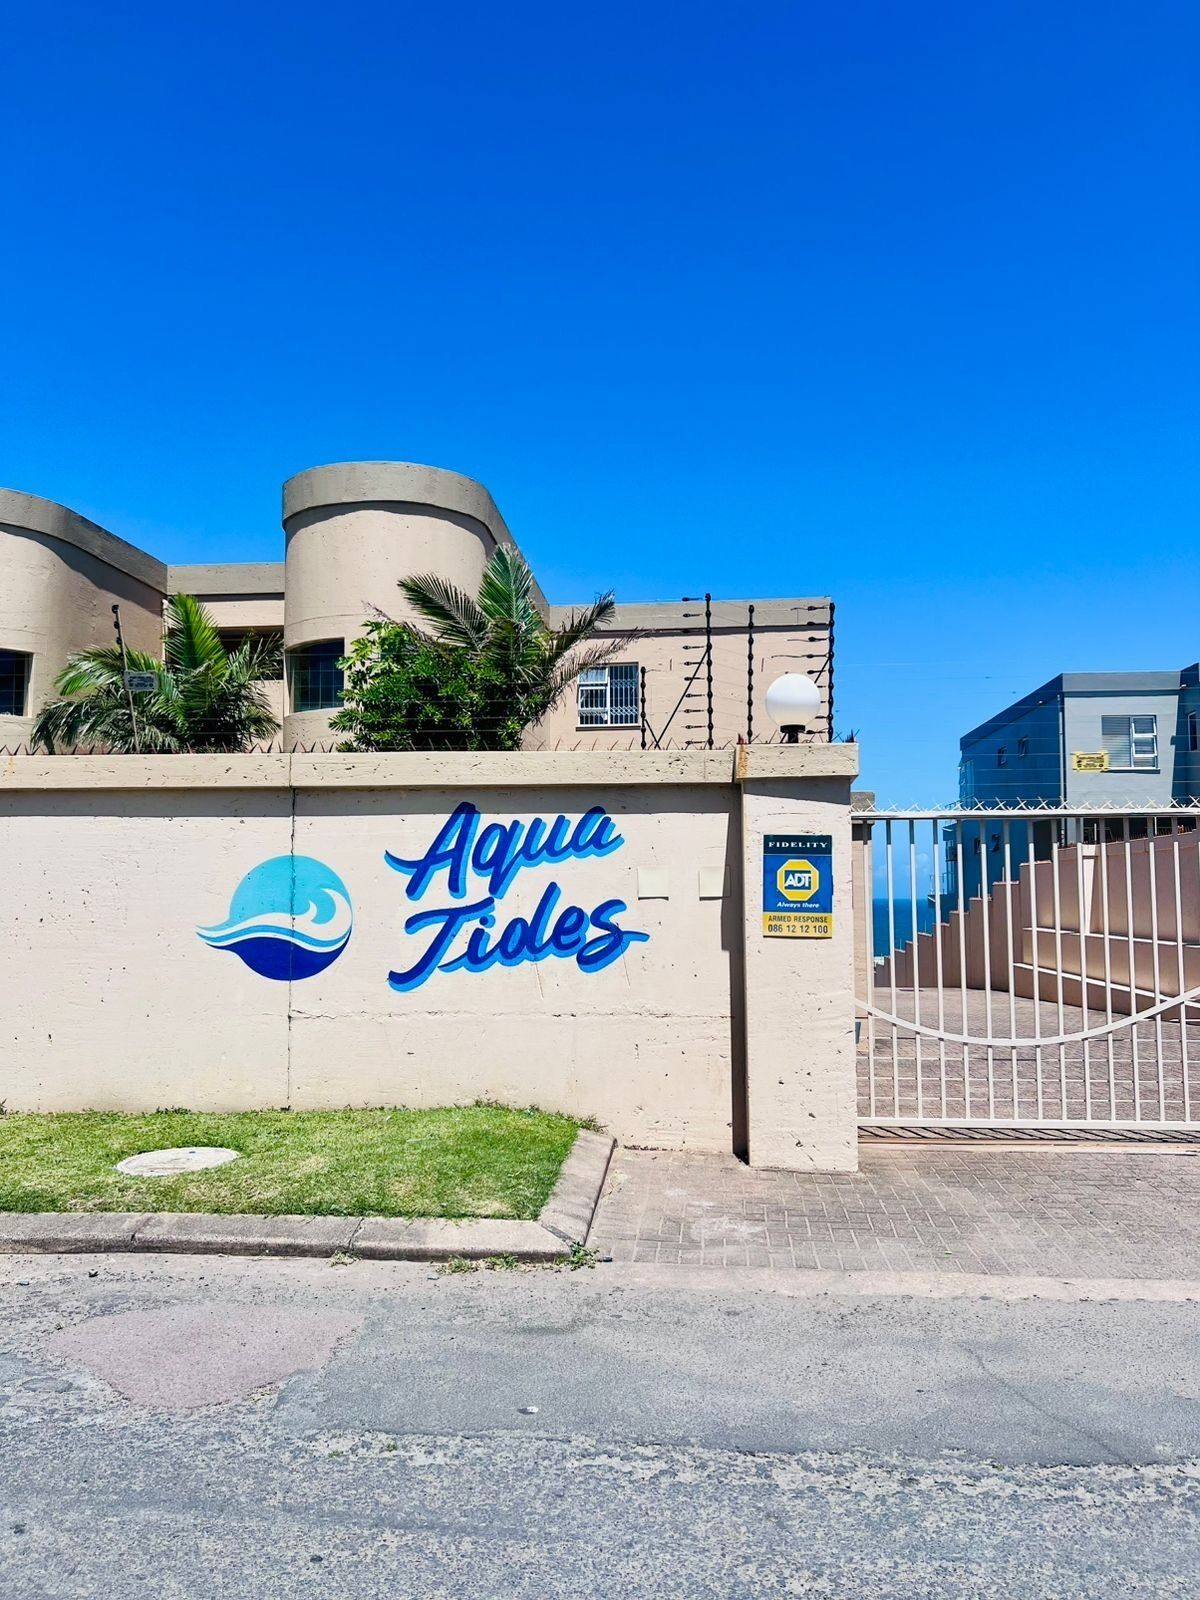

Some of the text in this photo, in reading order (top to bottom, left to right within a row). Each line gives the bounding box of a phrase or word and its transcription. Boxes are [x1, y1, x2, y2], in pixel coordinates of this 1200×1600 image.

[384, 802, 625, 900] Aqua
[784, 873, 812, 887] ADT
[776, 901, 801, 909] Always
[768, 915, 792, 923] ARMED
[768, 924, 828, 934] 086 12 12 100
[388, 881, 650, 992] Tides
